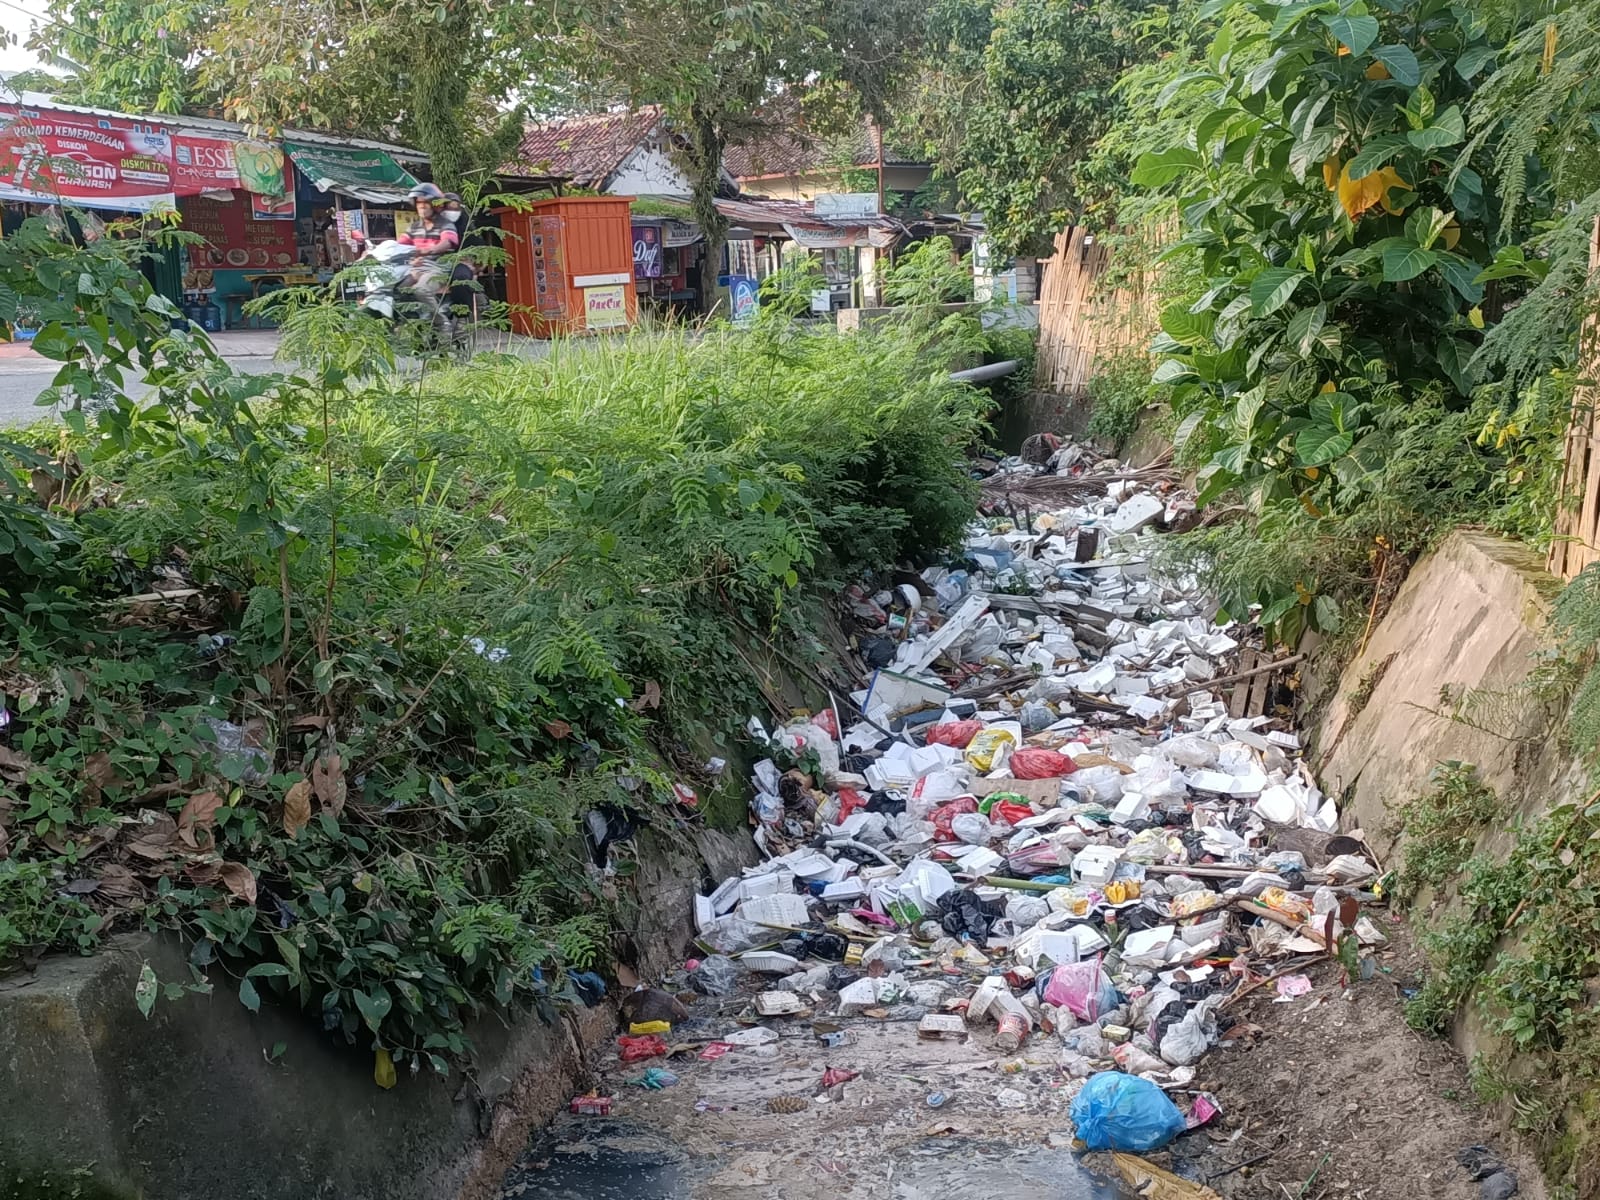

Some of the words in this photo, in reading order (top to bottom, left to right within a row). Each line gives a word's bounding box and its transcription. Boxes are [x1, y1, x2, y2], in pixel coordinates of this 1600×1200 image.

[54, 125, 125, 151] KEMERDEKAAN
[57, 140, 88, 151] DISKON
[120, 158, 150, 171] DISKON
